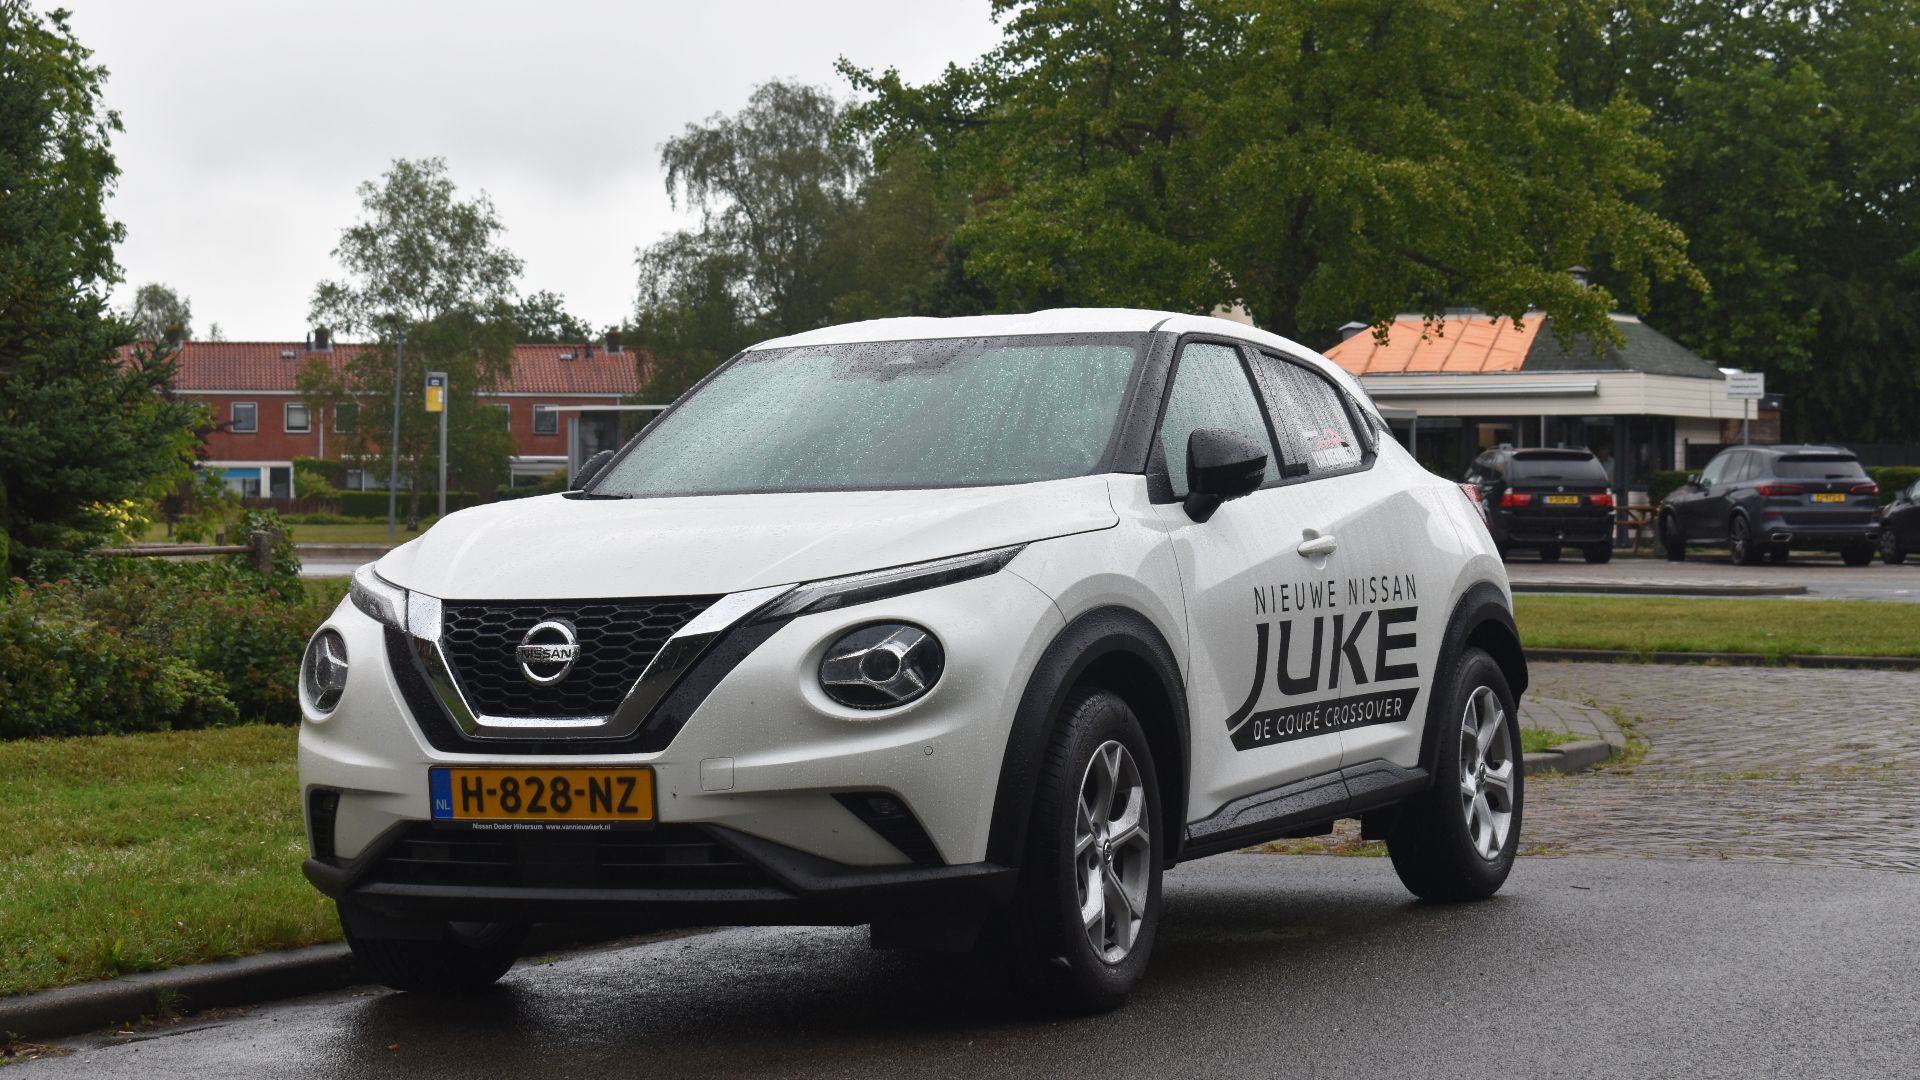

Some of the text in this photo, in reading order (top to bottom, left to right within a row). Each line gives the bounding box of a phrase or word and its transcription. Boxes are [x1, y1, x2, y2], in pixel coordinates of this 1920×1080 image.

[1253, 574, 1417, 615] NIEUWE NISSAN
[521, 648, 572, 659] NISSAN
[1225, 606, 1419, 731] JUKE
[1253, 697, 1402, 740] DE COUPÉ CROSSOVER
[436, 799, 450, 810] NL
[460, 776, 638, 813] H-828-NZ
